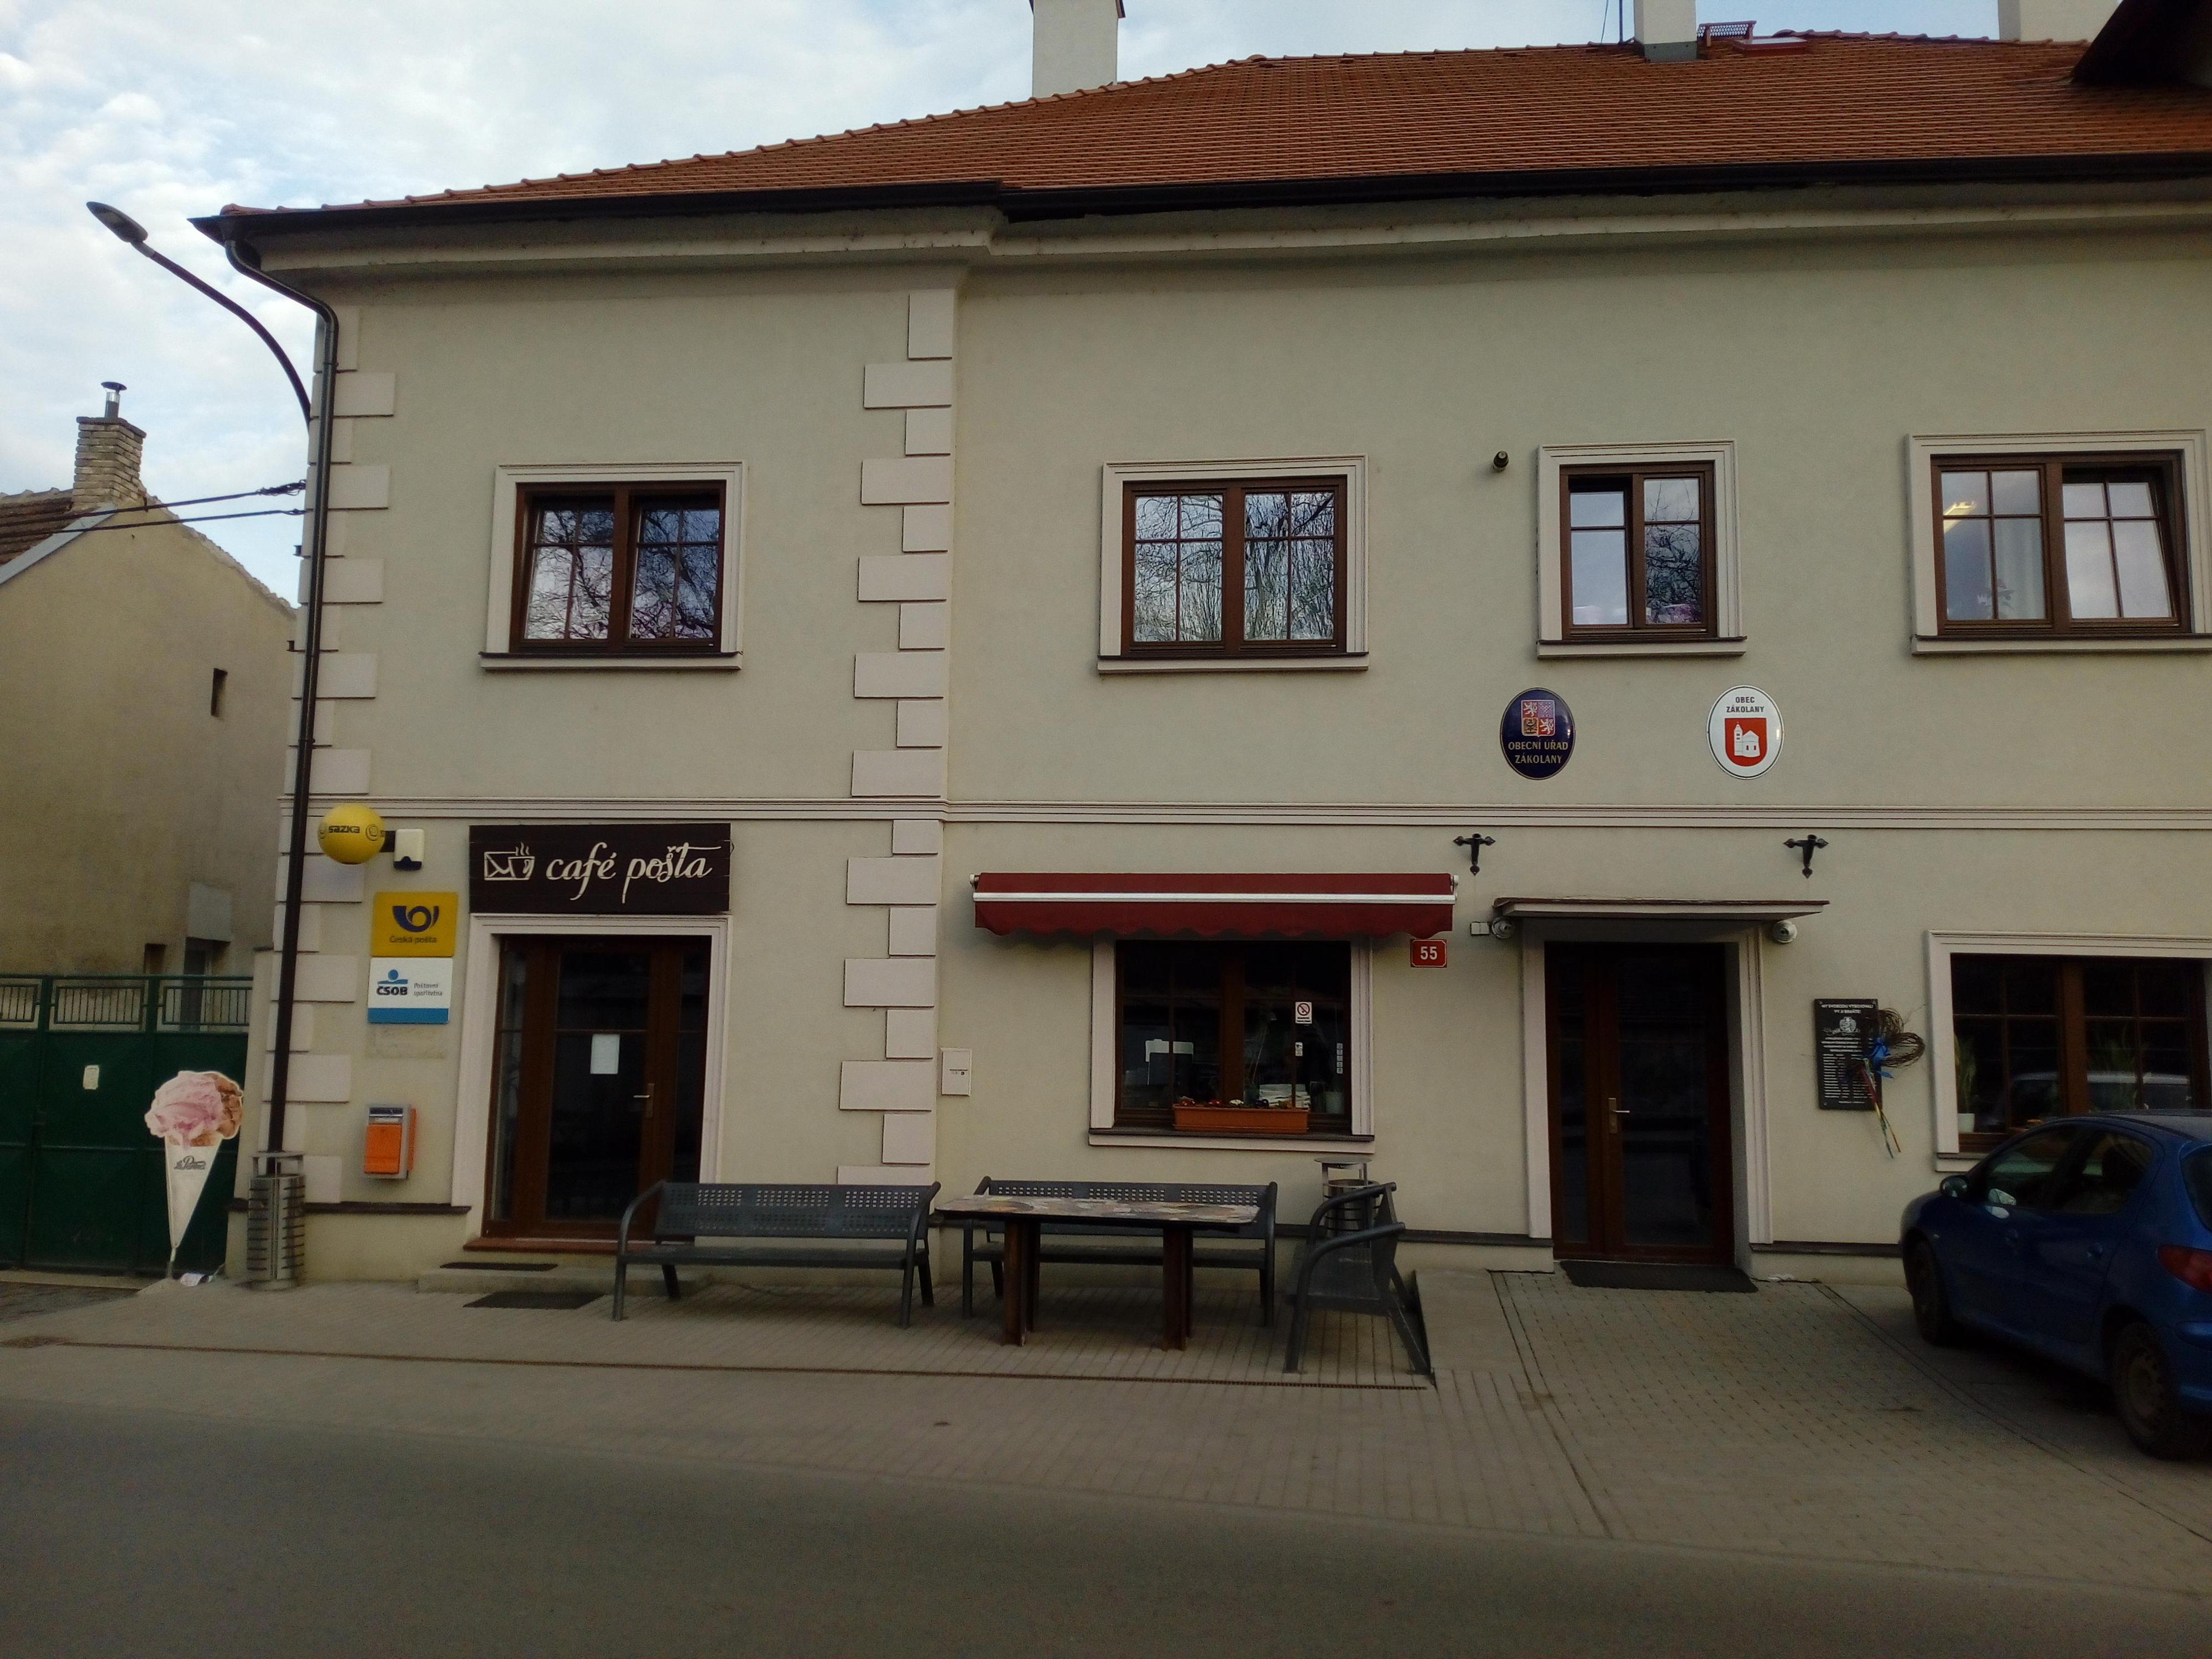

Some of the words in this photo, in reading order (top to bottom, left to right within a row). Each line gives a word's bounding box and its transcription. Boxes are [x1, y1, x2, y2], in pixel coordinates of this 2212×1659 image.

[1726, 705, 1764, 713] ZÁKOLANY
[1508, 739, 1541, 750] OBECNÍ
[1544, 740, 1568, 750] ÚŘAD
[1515, 753, 1562, 763] ZÁKOLANY
[546, 842, 617, 900] café
[621, 842, 721, 904] pošta
[1420, 946, 1437, 960] 55
